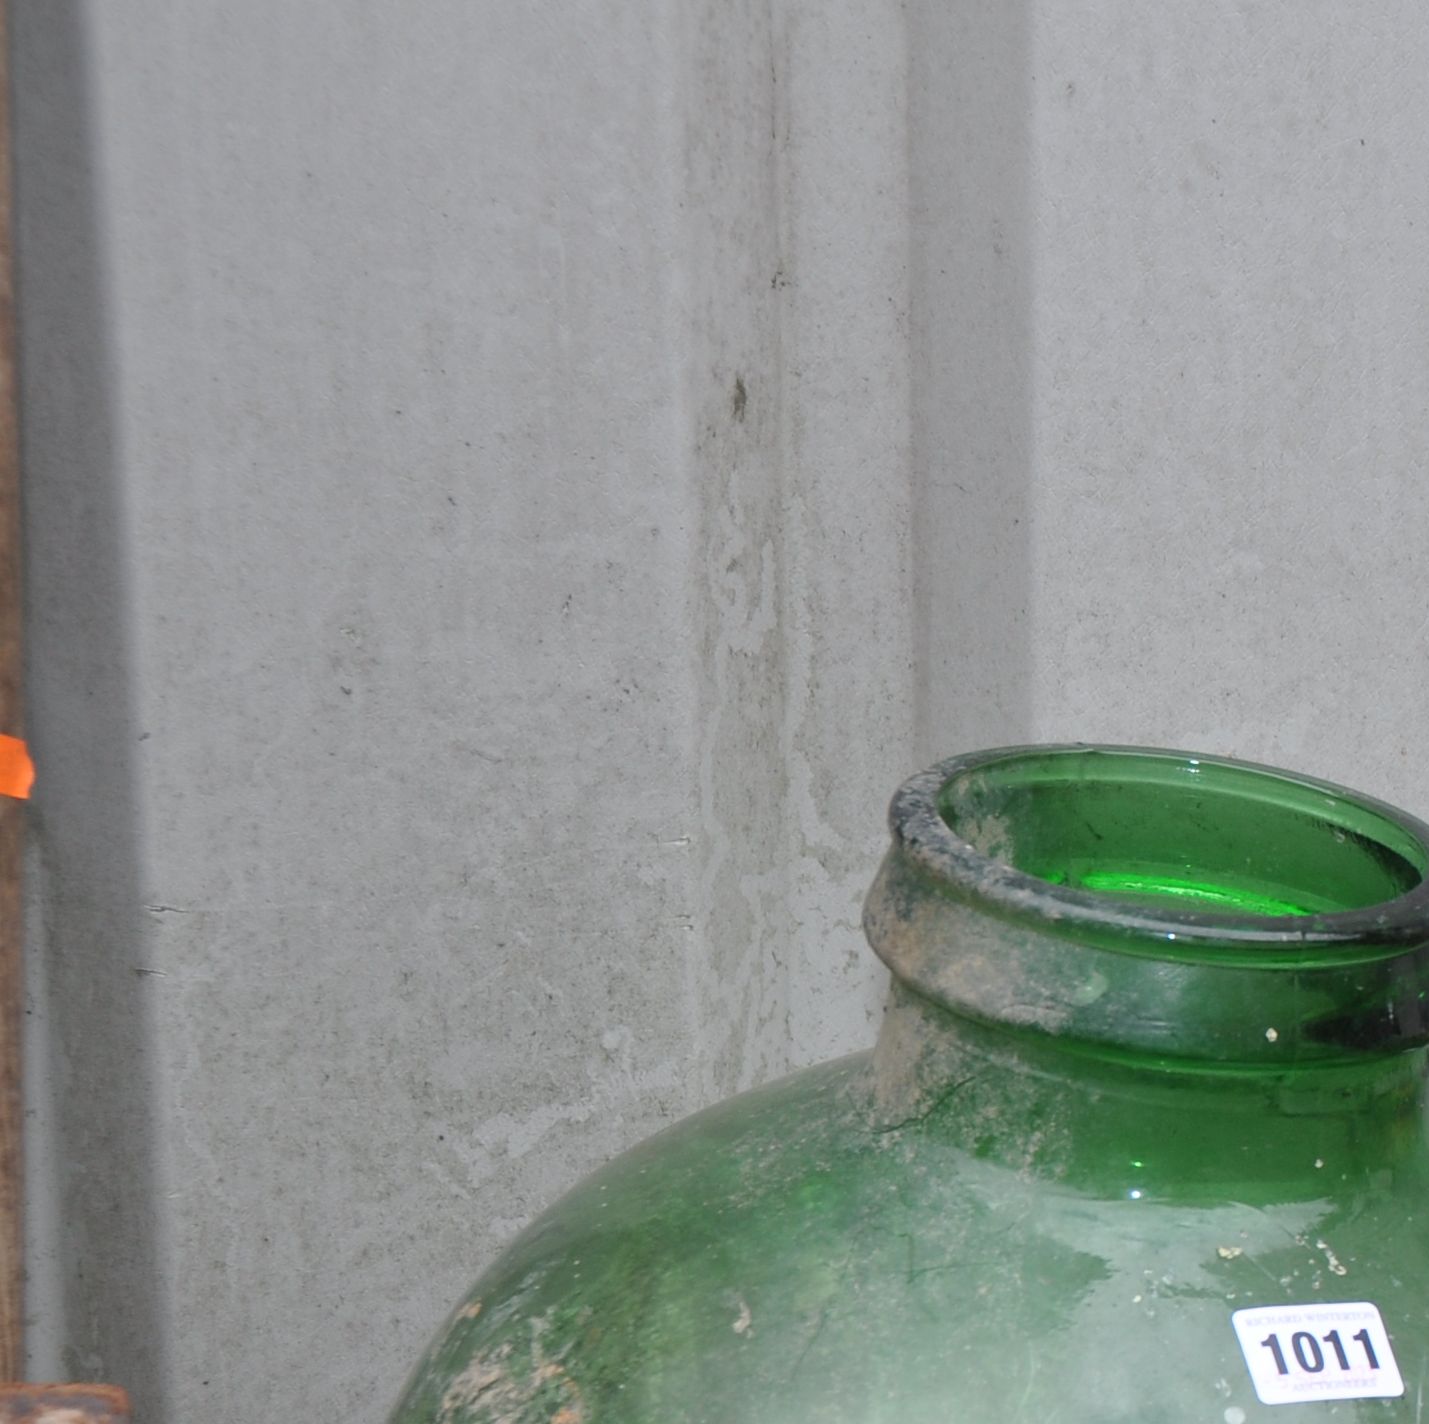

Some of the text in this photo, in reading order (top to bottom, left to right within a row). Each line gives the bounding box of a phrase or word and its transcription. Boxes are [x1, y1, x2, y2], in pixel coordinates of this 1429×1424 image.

[1246, 1310, 1376, 1326] RICHARD WINTERTON
[1260, 1328, 1381, 1376] 1011
